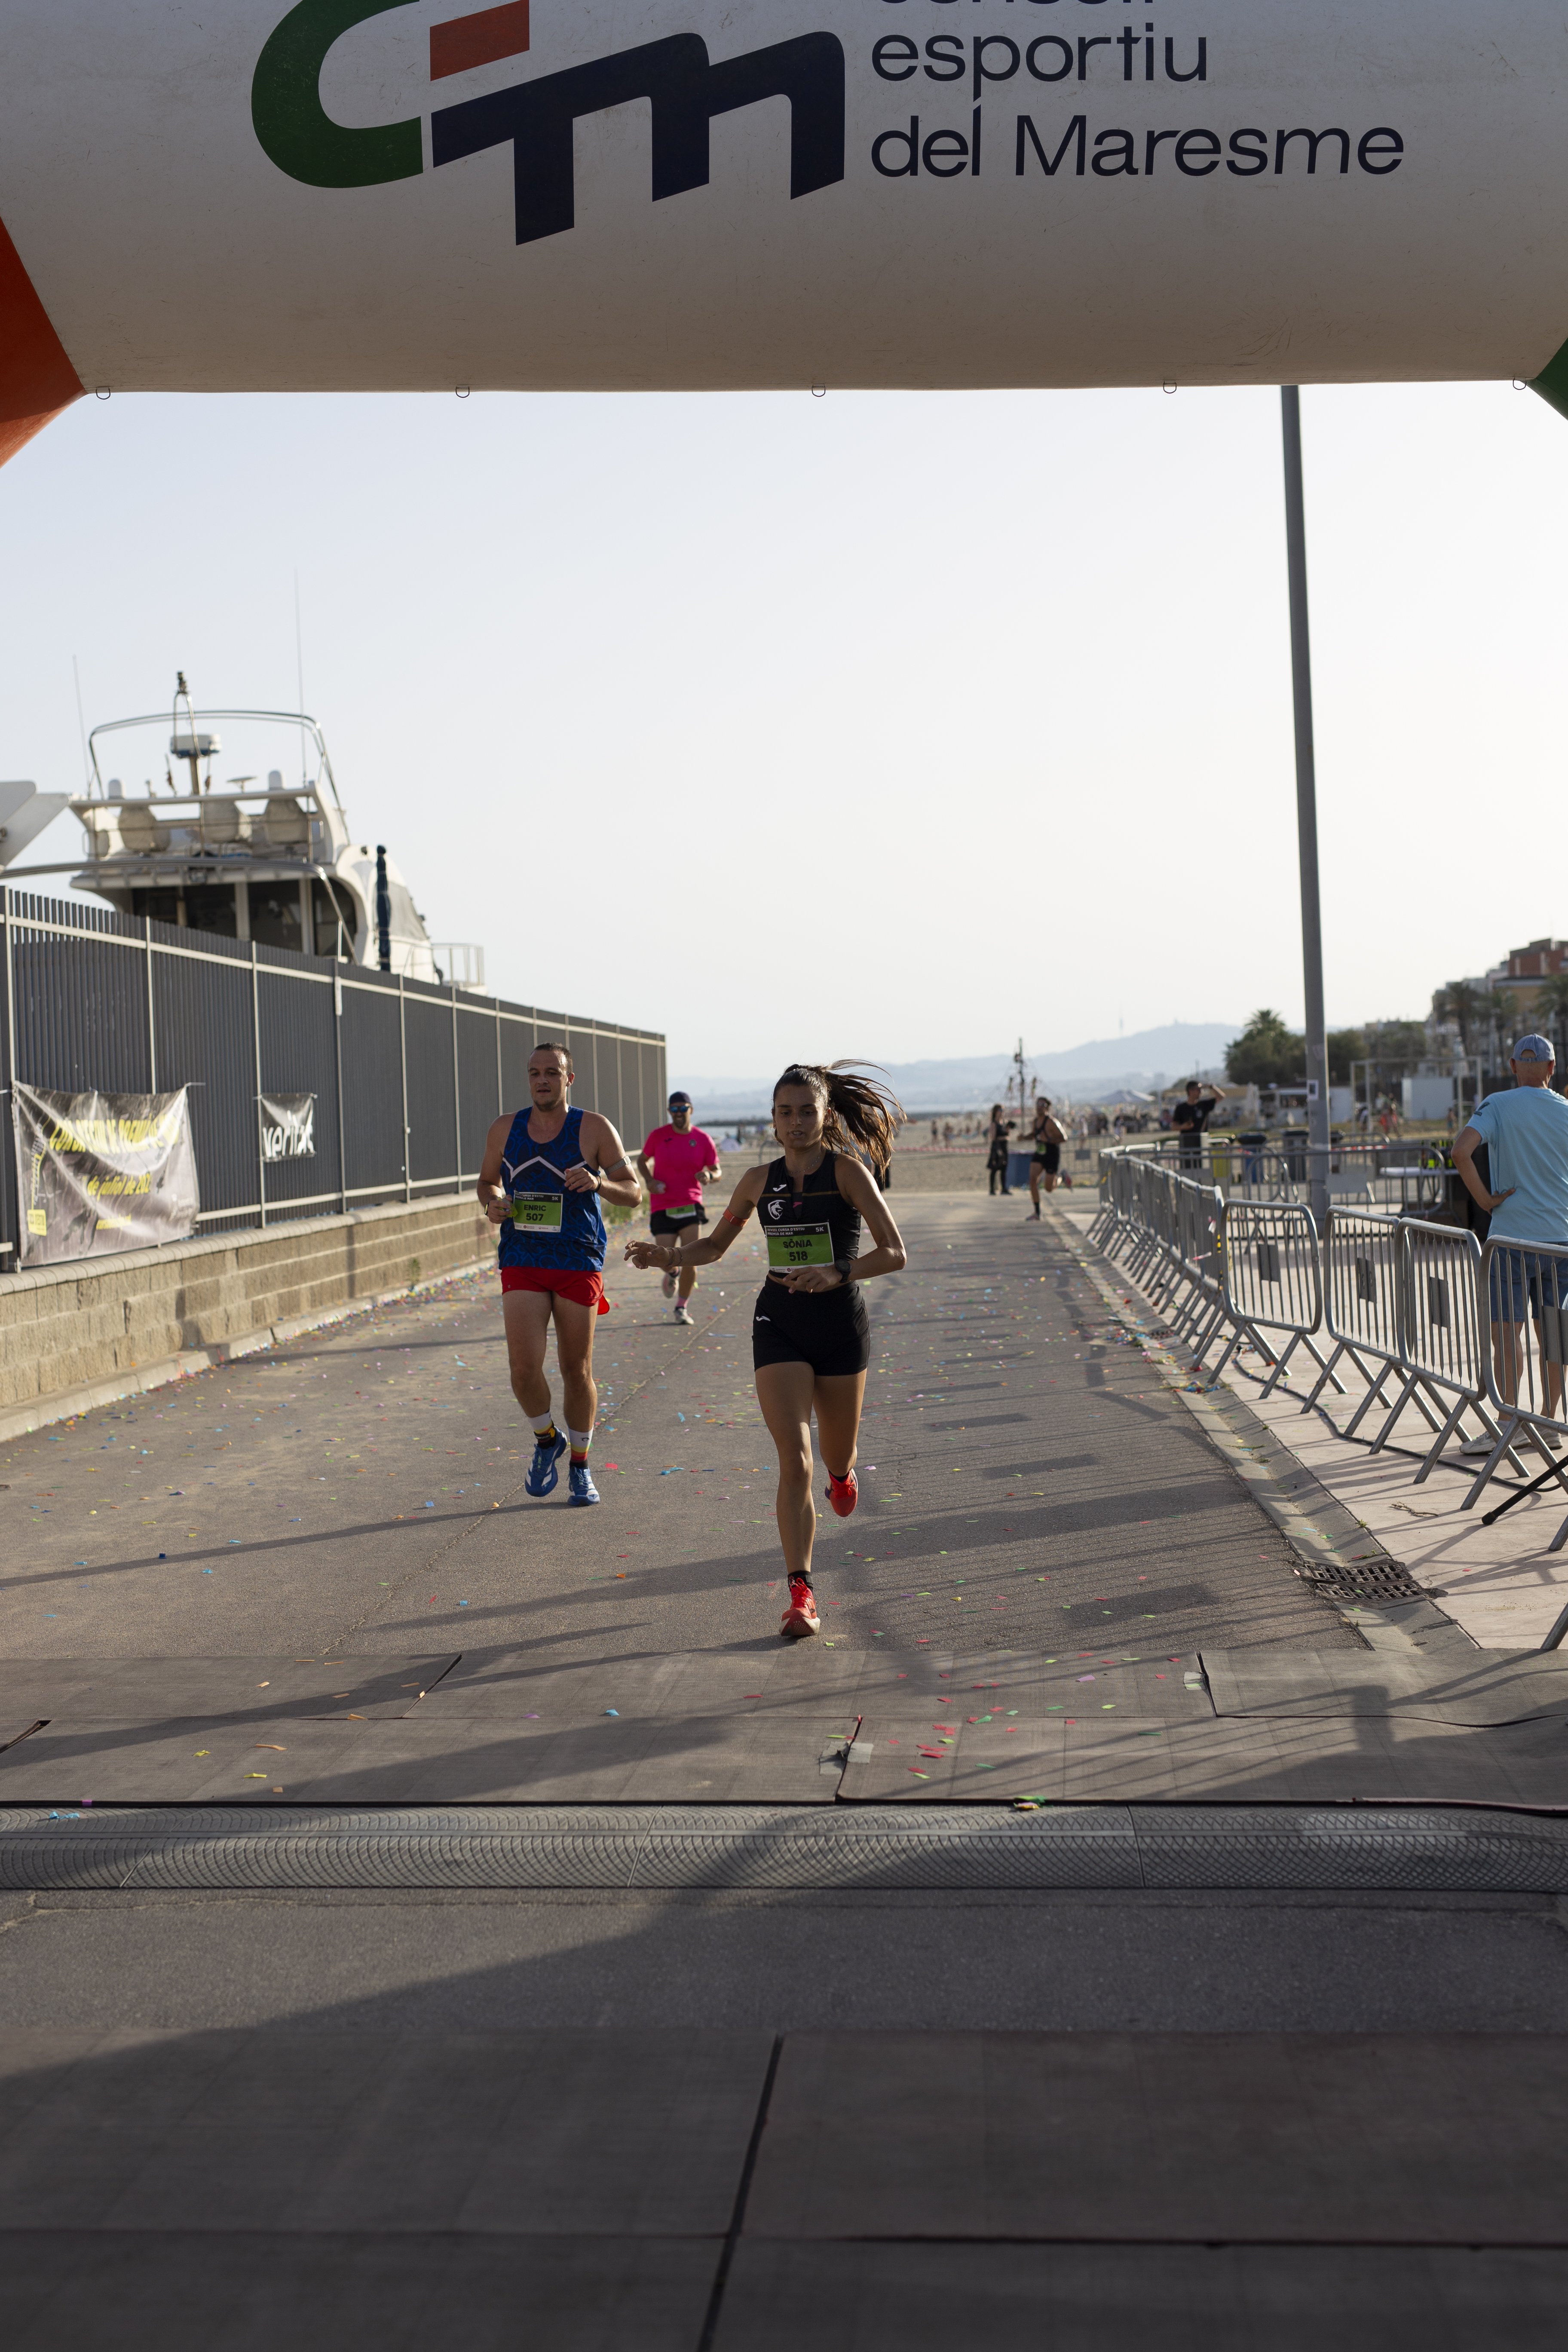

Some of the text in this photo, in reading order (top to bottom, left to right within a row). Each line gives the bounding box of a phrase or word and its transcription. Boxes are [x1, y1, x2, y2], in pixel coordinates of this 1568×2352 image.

[871, 22, 1207, 103] esportiu
[870, 104, 1404, 178] del Maresme
[526, 1213, 544, 1222] 507
[783, 1238, 813, 1249] SÒNIA
[789, 1251, 808, 1262] 518
